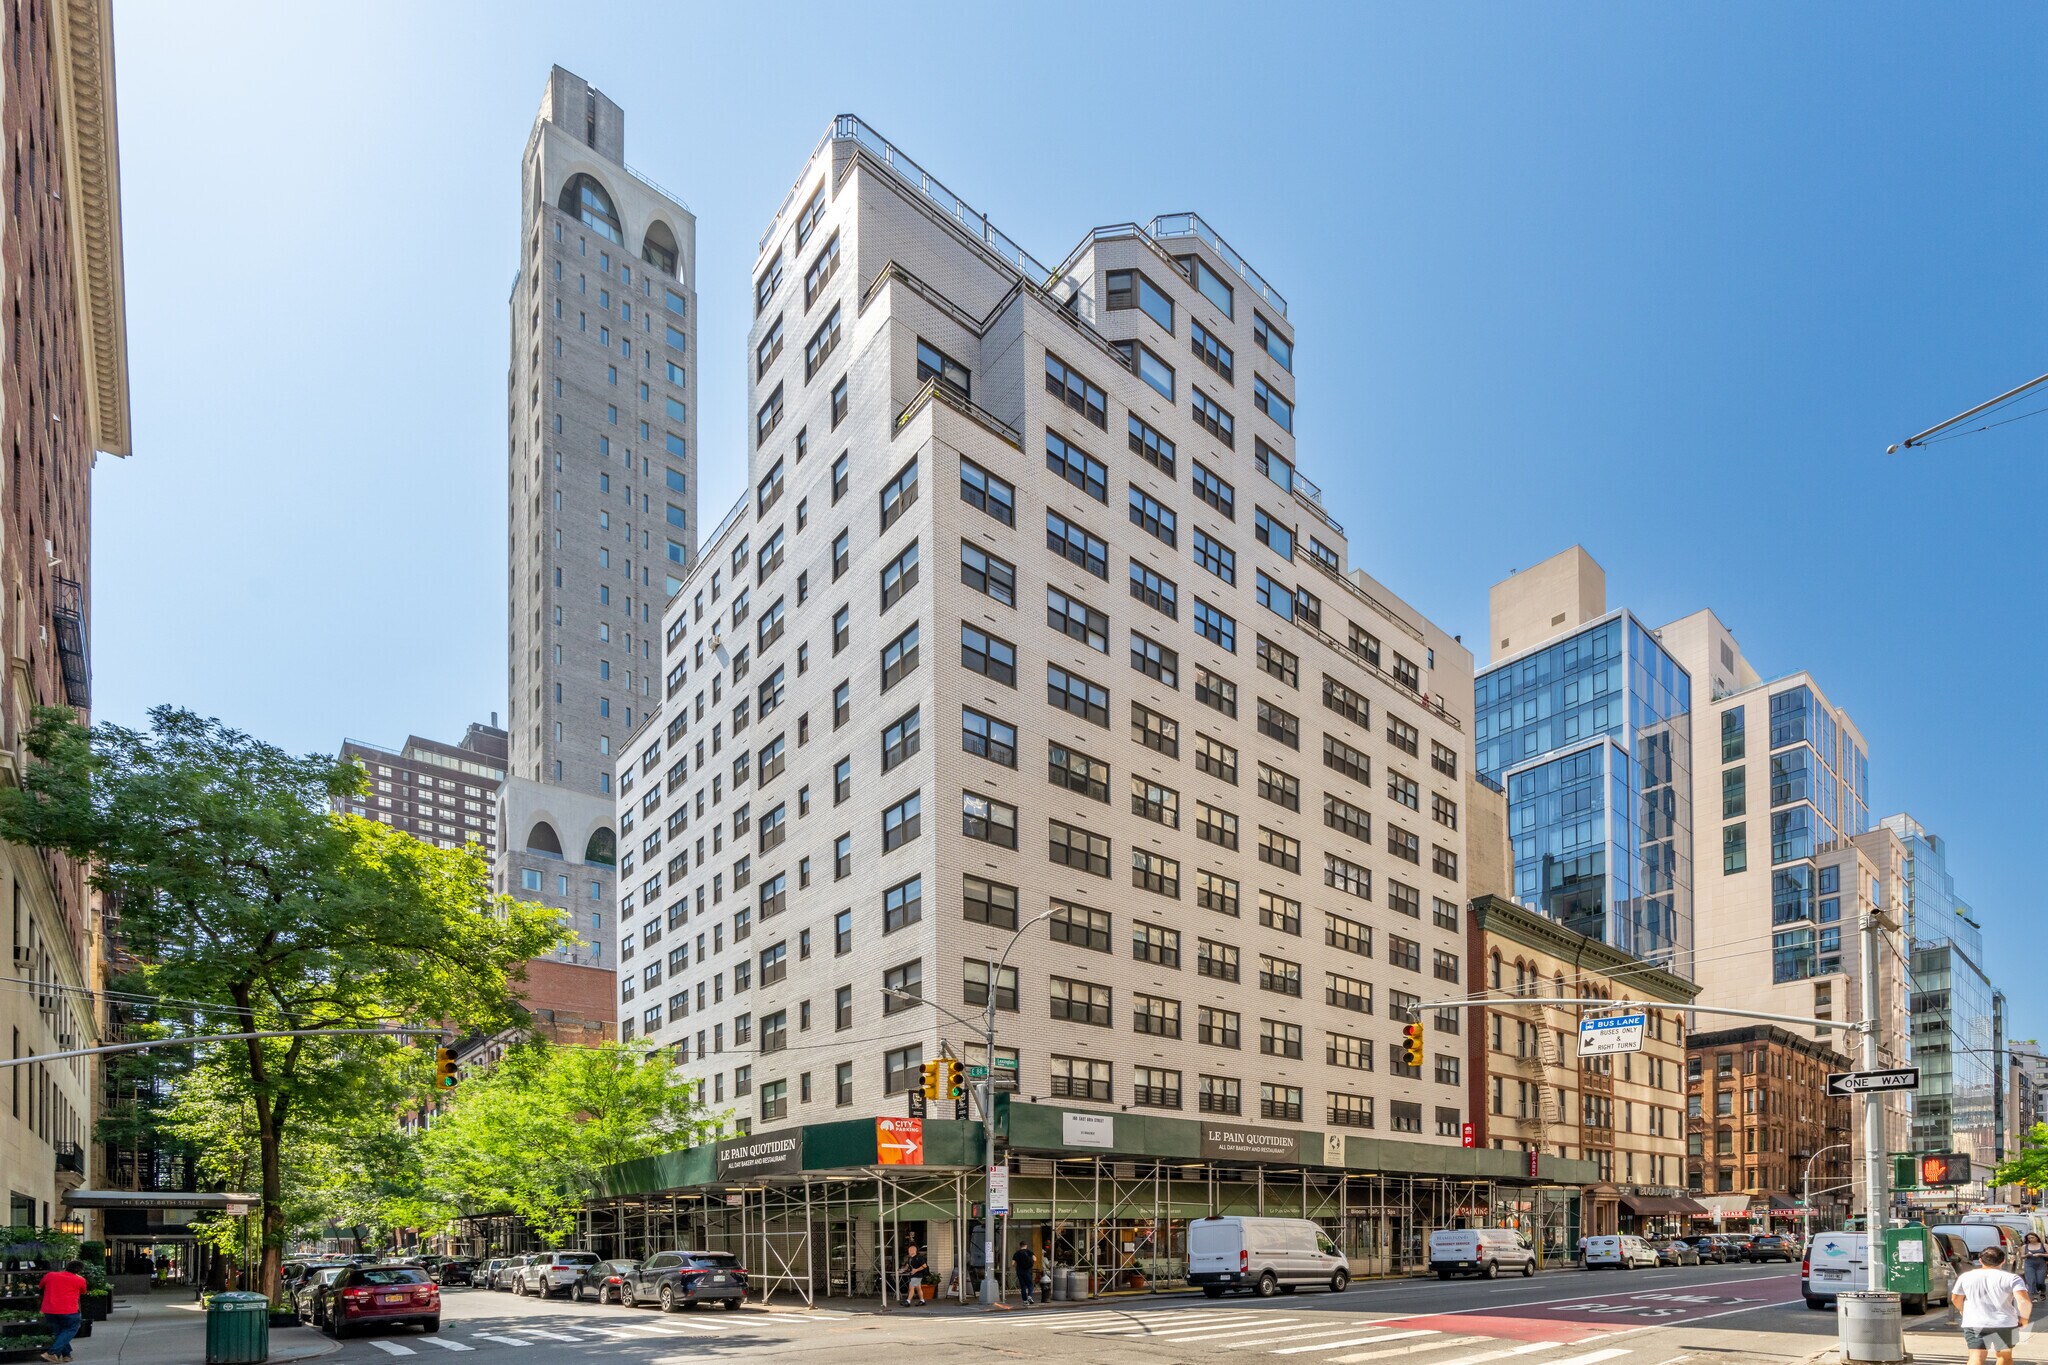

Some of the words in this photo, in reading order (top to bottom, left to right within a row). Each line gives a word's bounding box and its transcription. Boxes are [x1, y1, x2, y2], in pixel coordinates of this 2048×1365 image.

[1845, 1078, 1868, 1088] ONE
[1882, 1075, 1908, 1085] WAY
[1209, 1131, 1220, 1141] LE
[1223, 1132, 1244, 1143] PAIN
[1247, 1134, 1294, 1147] QUOTIDIEN
[721, 1150, 730, 1160] LE
[731, 1146, 748, 1159] PAIN
[750, 1139, 796, 1156] QUOTIDIEN
[763, 1155, 786, 1164] RESTAURANT
[1547, 1303, 1687, 1317] BUS
